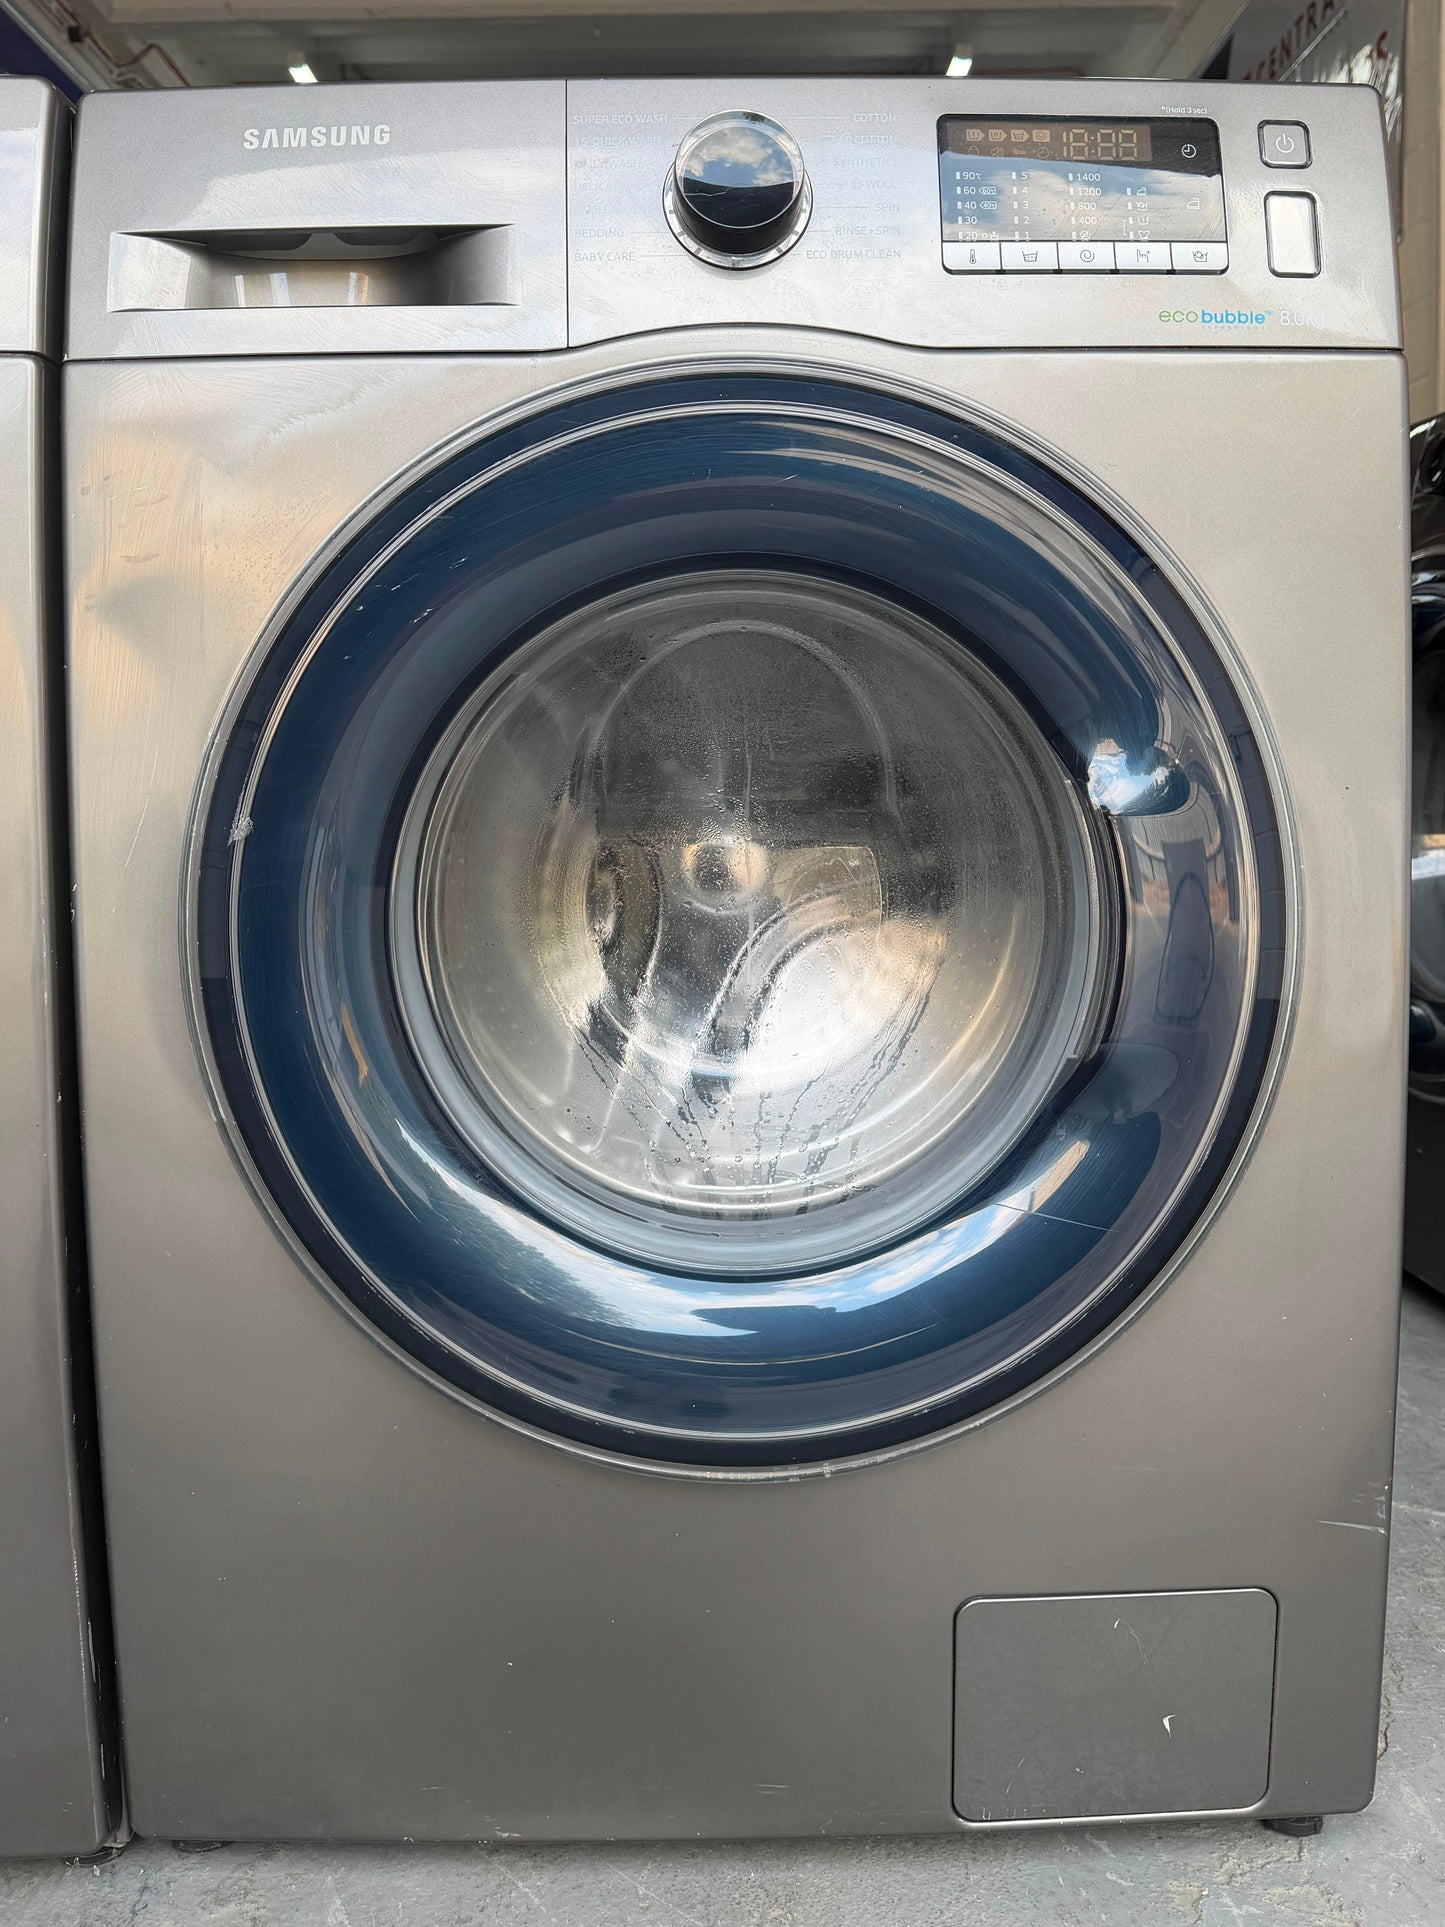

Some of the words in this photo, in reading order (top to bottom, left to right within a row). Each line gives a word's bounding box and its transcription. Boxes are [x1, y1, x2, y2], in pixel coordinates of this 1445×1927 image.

[1193, 107, 1207, 115] sec)
[573, 115, 609, 124] SUPER
[611, 115, 633, 124] ECO
[635, 114, 668, 123] WASH
[853, 113, 897, 122] COTTON
[243, 124, 391, 150] SAMSUNG
[592, 137, 626, 146] QUICK
[854, 134, 897, 143] COTTON
[1021, 172, 1028, 180] 5
[1076, 173, 1101, 181] 1400
[964, 187, 976, 195] 60
[1078, 187, 1102, 195] 1200
[874, 203, 900, 212] SPIN
[965, 201, 977, 209] 40
[1023, 201, 1029, 209] 3
[1078, 202, 1097, 210] 800
[965, 216, 978, 224] 30
[1024, 216, 1030, 224] 2
[1079, 216, 1097, 224] 400
[575, 229, 624, 238] BEDDING
[835, 226, 867, 236] RINSE
[966, 231, 978, 240] 20
[575, 252, 604, 261] BABY
[607, 251, 635, 261] CARE
[806, 250, 827, 259] ECO
[830, 250, 863, 259] DRUM
[865, 249, 901, 259] CLEAN
[1158, 310, 1199, 323] eco
